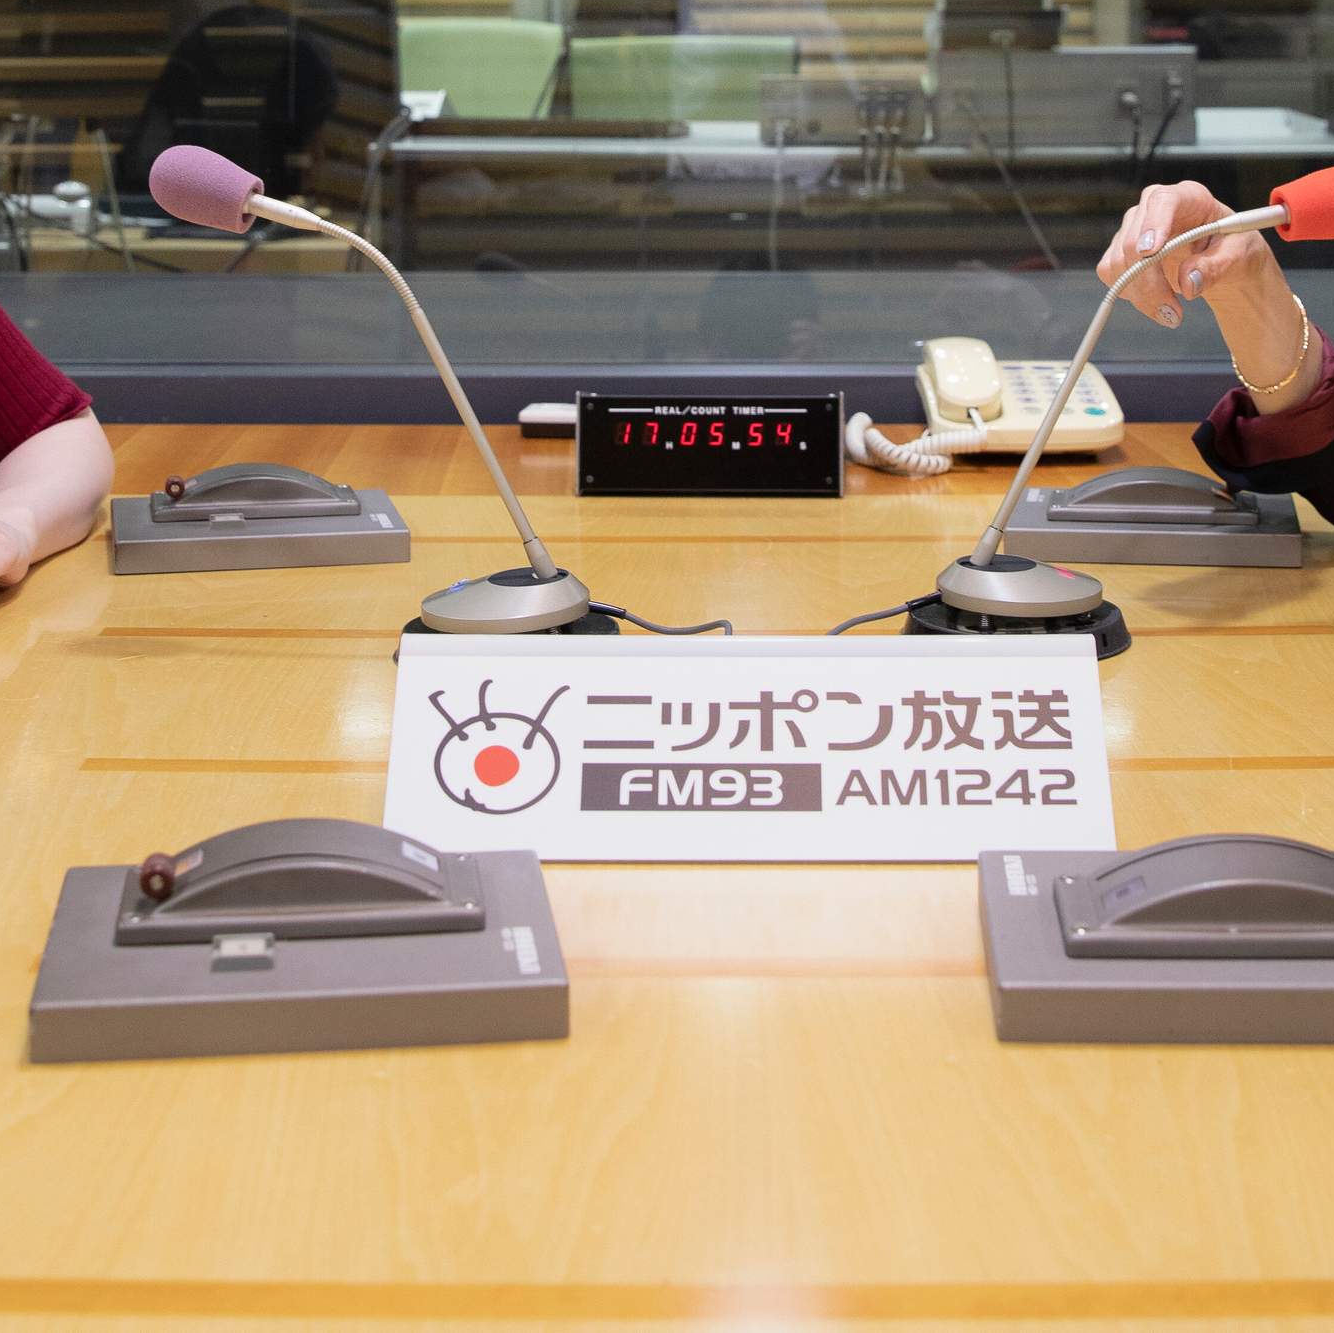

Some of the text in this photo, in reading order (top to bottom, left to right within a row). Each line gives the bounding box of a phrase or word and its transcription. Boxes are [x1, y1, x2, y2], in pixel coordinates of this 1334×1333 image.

[654, 405, 765, 416] REAL/COUNT TIMER
[582, 689, 1073, 752] ニッポン放送
[618, 768, 1078, 806] FM93 AM1242
